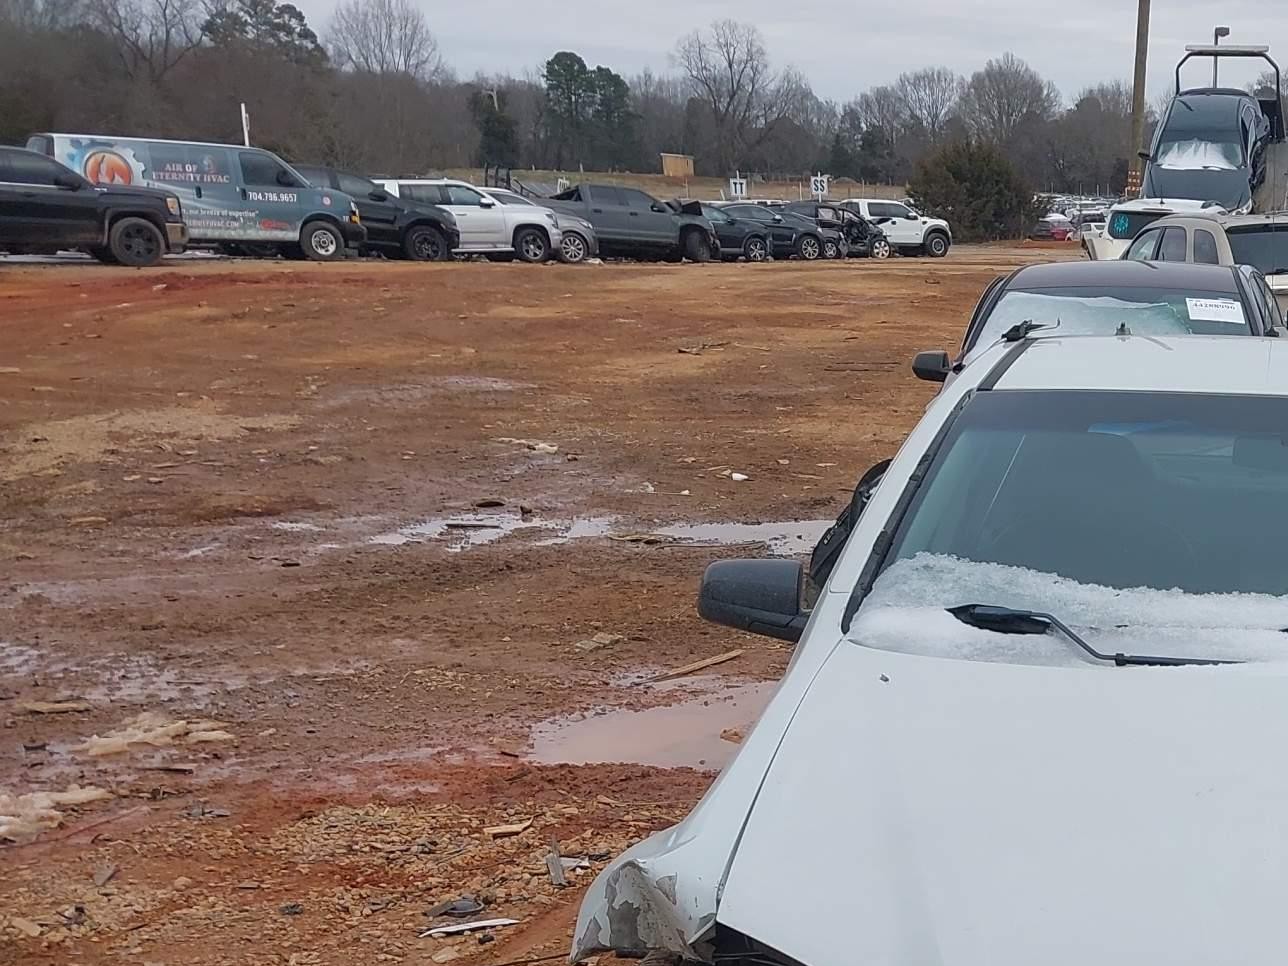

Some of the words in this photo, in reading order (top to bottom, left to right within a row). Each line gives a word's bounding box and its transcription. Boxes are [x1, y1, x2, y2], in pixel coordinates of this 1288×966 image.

[165, 163, 183, 172] AIR
[185, 163, 199, 173] OF
[152, 171, 201, 182] ETERNITY
[203, 174, 230, 184] HVAC
[732, 181, 744, 195] TT
[813, 178, 825, 193] SS
